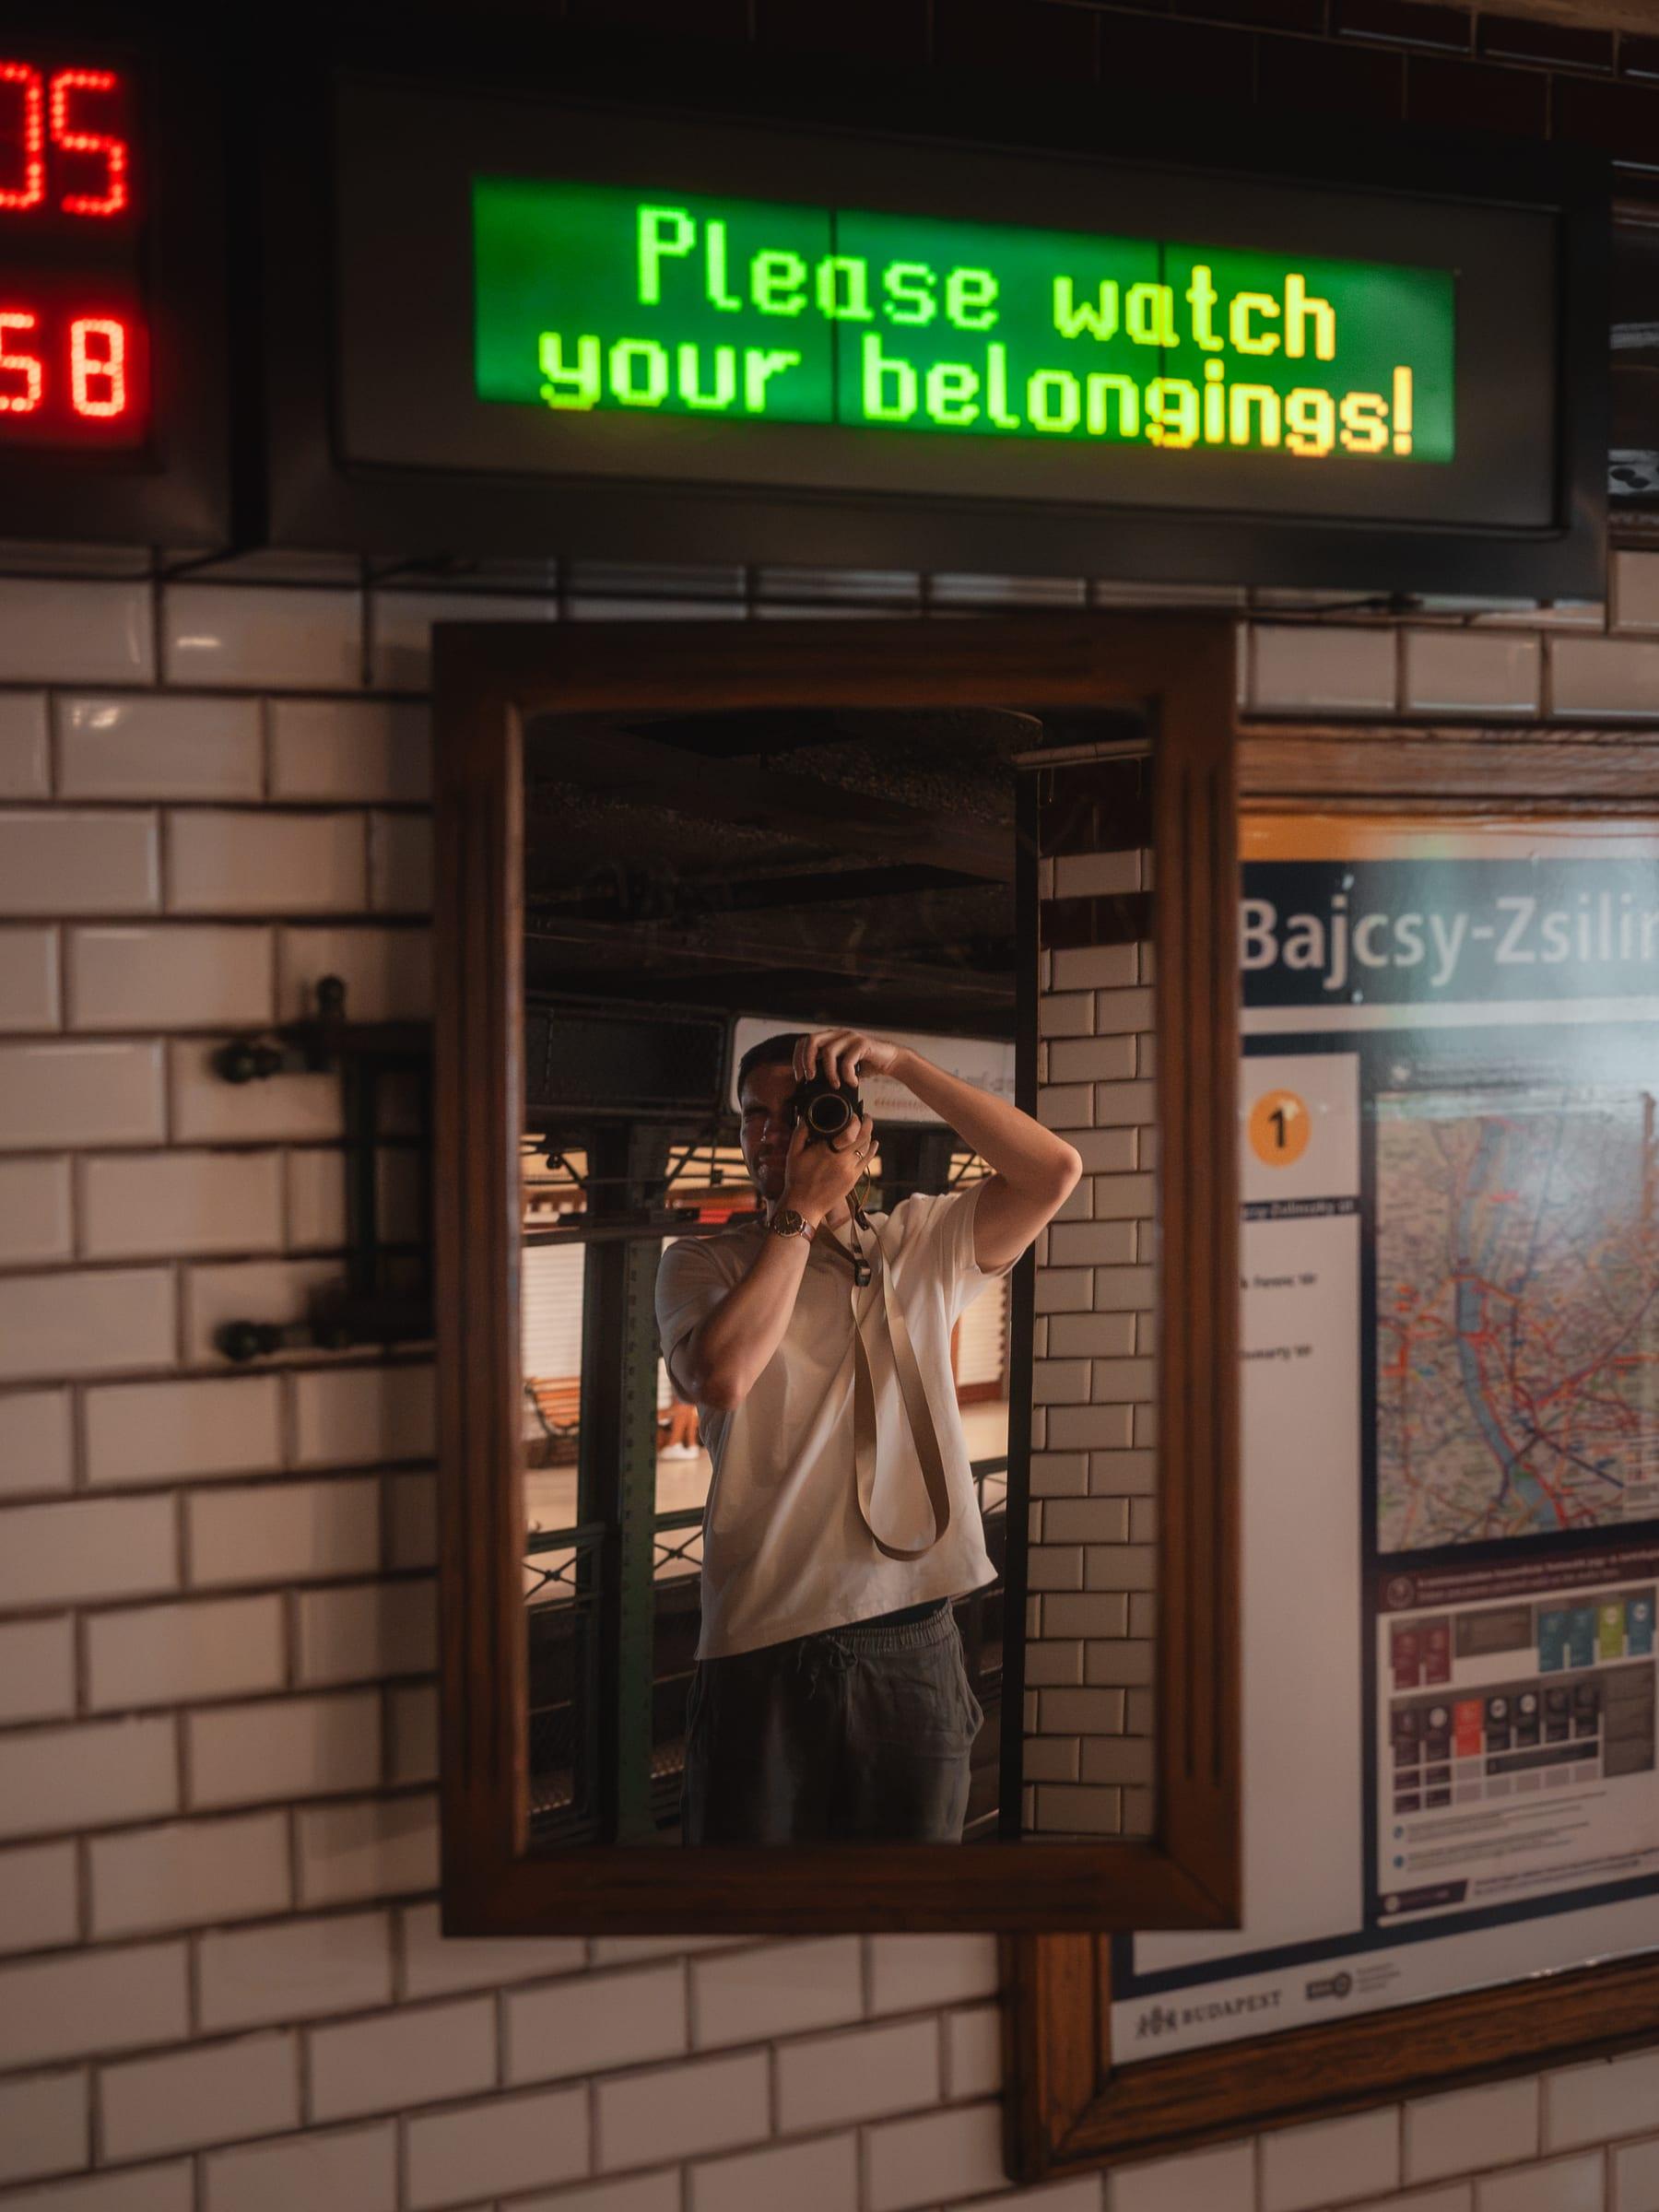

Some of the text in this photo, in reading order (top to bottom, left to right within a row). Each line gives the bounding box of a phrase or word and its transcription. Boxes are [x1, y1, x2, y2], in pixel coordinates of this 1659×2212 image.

[636, 205, 1336, 362] Please watch
[538, 330, 1415, 459] your belongings!
[1268, 1108, 1286, 1149] 1
[1182, 1989, 1282, 2026] BUDAPEST
